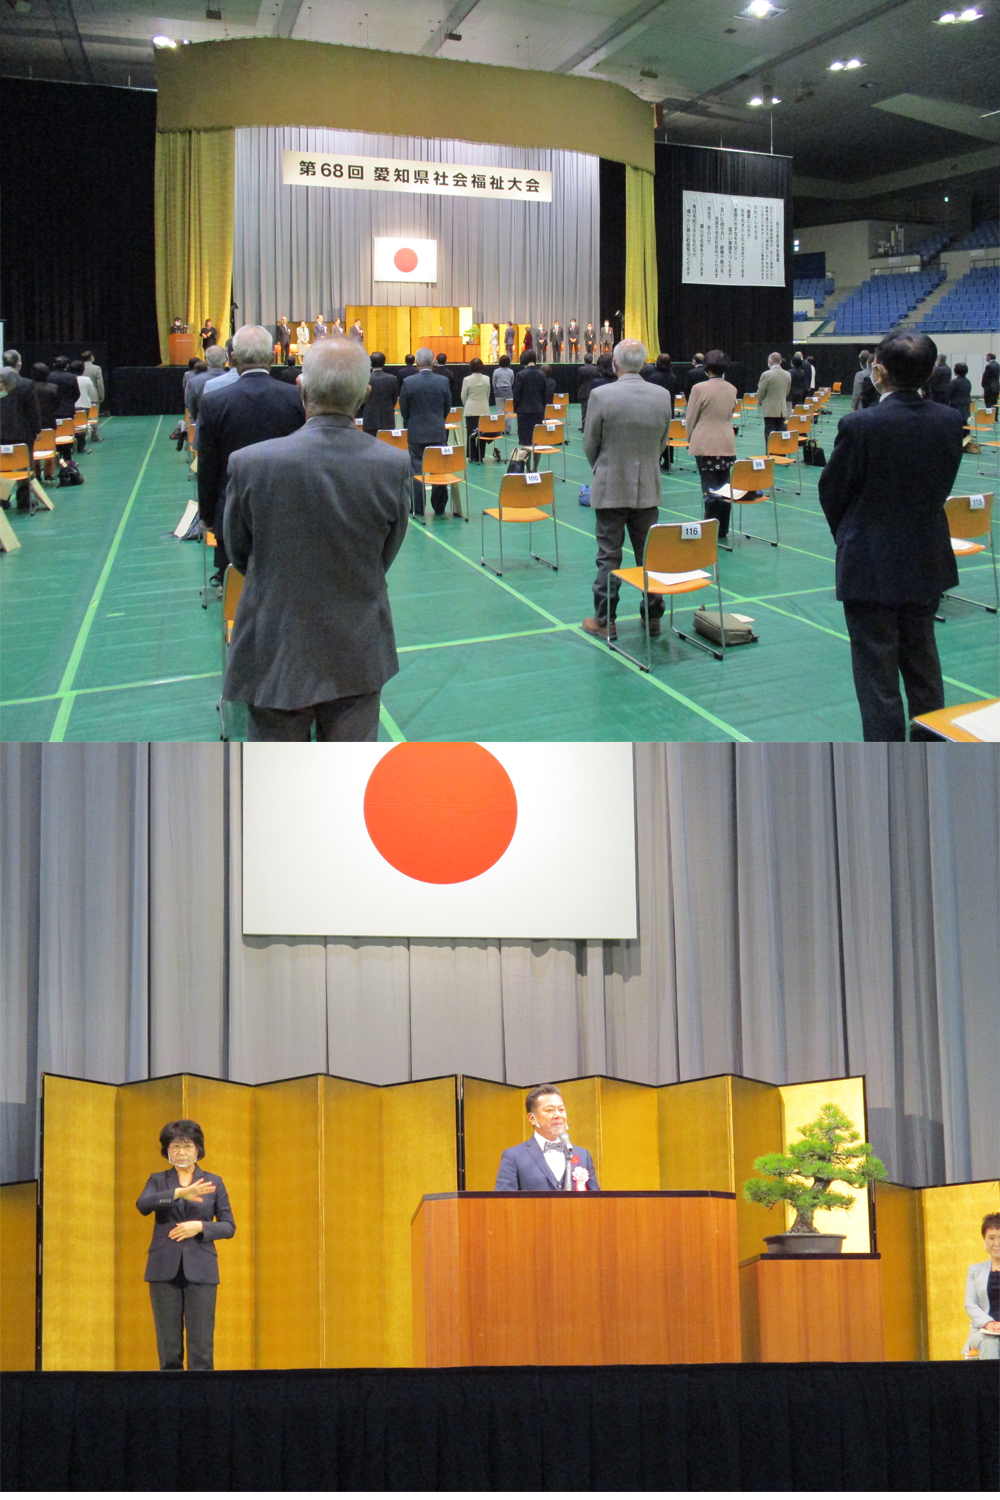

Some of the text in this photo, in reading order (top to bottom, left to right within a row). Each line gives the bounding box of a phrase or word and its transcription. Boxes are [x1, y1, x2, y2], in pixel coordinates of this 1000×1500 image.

[299, 159, 540, 193] 第68回 愛知県社会福祉大会
[685, 527, 698, 536] 116
